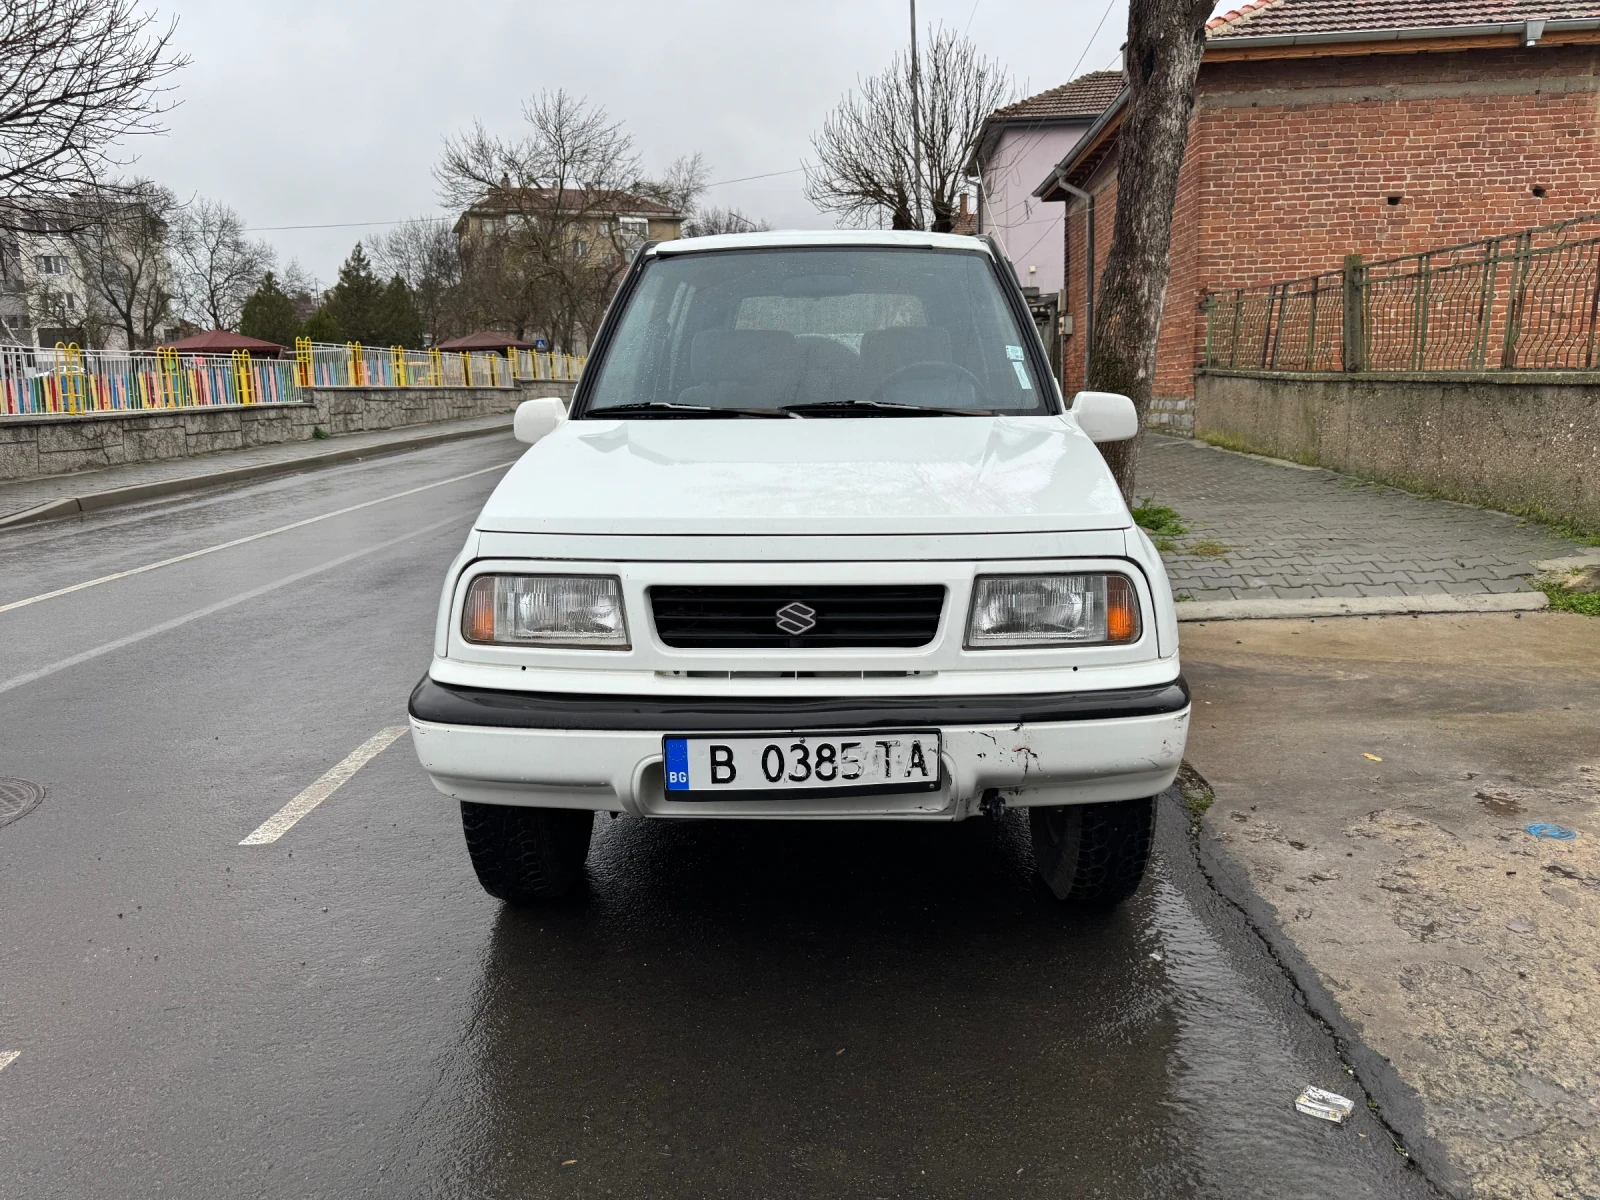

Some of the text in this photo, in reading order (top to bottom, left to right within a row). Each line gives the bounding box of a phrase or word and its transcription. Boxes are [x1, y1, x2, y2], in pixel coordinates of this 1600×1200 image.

[710, 740, 929, 784] B 0385 TA
[669, 772, 687, 783] BG
